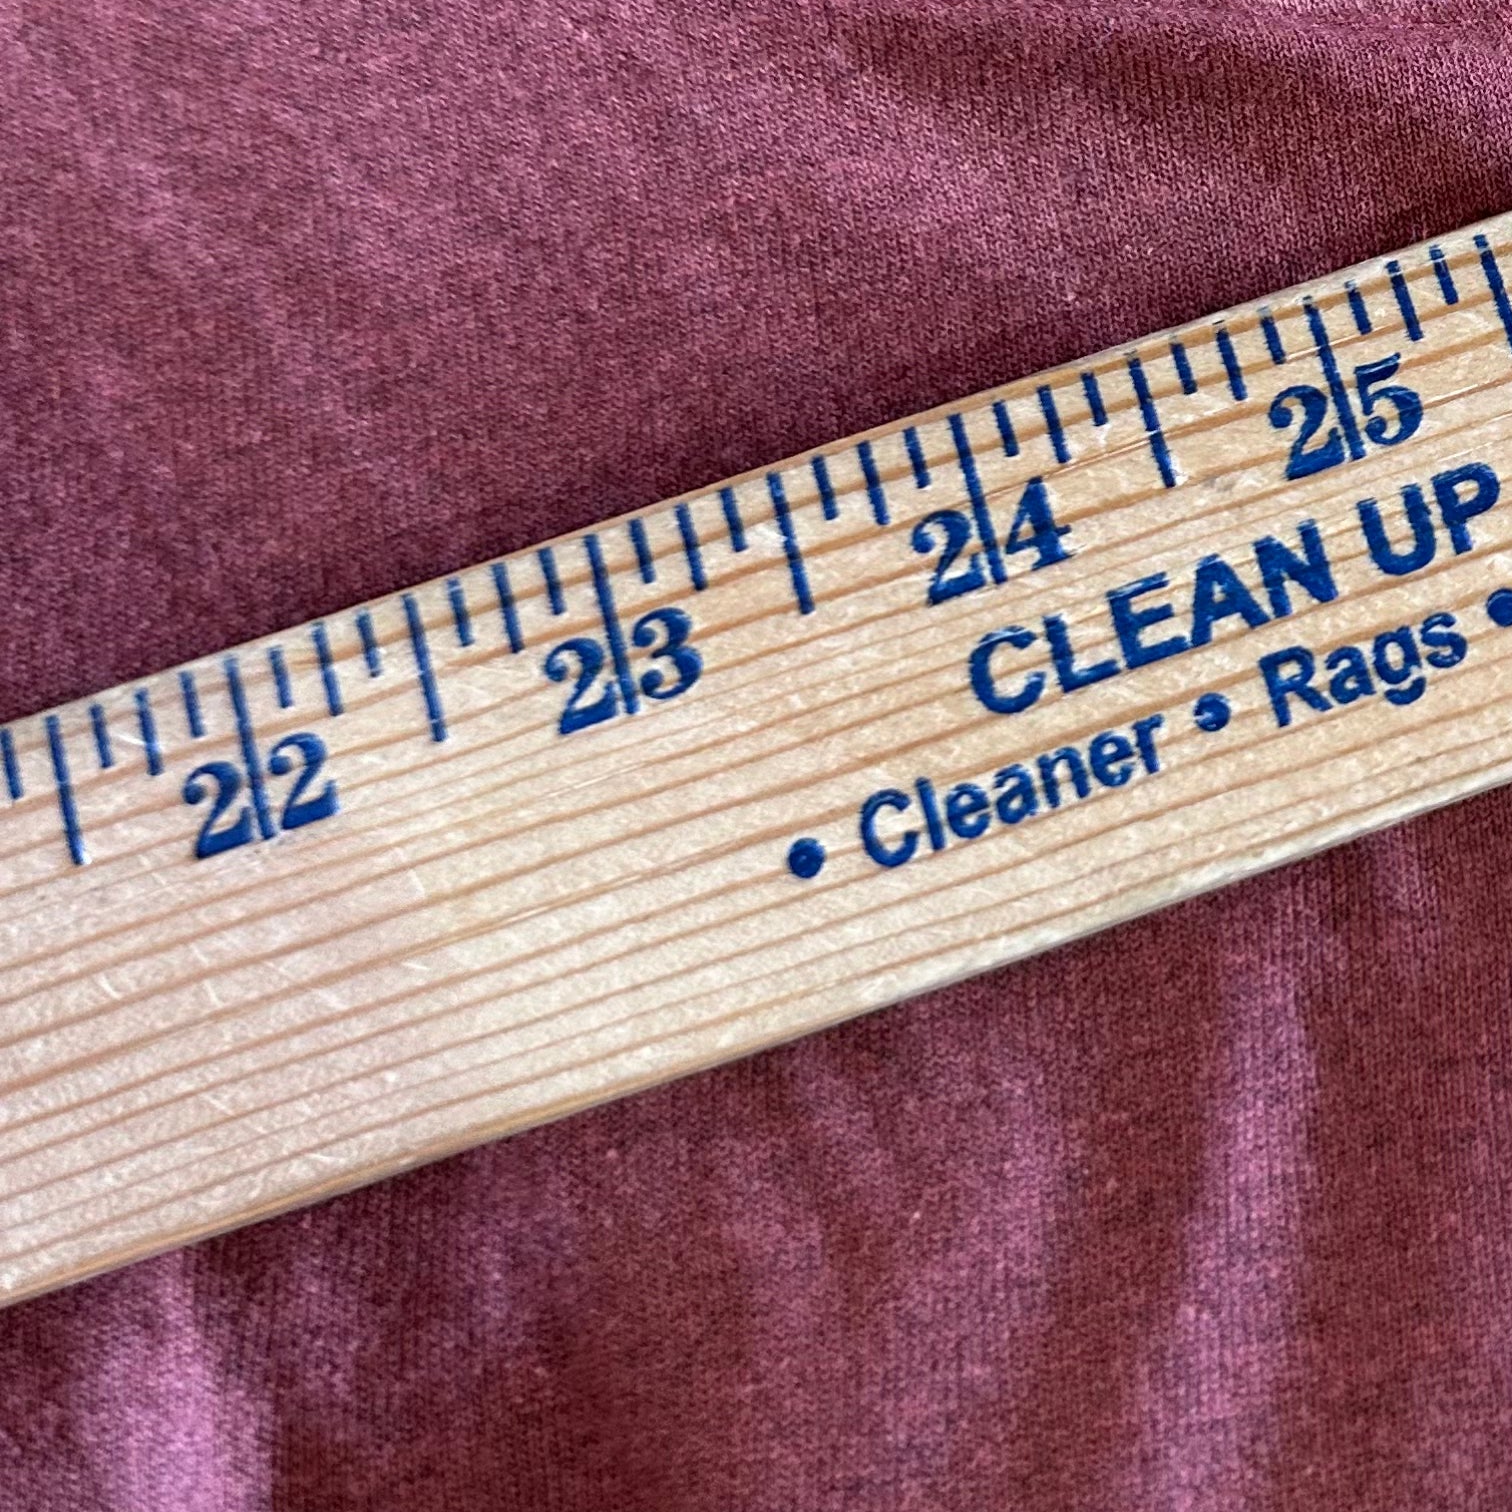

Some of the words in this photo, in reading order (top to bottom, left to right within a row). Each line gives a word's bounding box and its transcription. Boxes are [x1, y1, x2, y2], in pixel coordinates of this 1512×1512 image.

[183, 733, 340, 858] 22
[544, 608, 702, 735] 23
[911, 478, 1069, 604] 24
[1269, 354, 1422, 480] 25
[968, 520, 1339, 715] CLEAN
[1356, 463, 1500, 575] UP
[859, 715, 1164, 869] Cleaner
[1258, 612, 1467, 728] Rags
